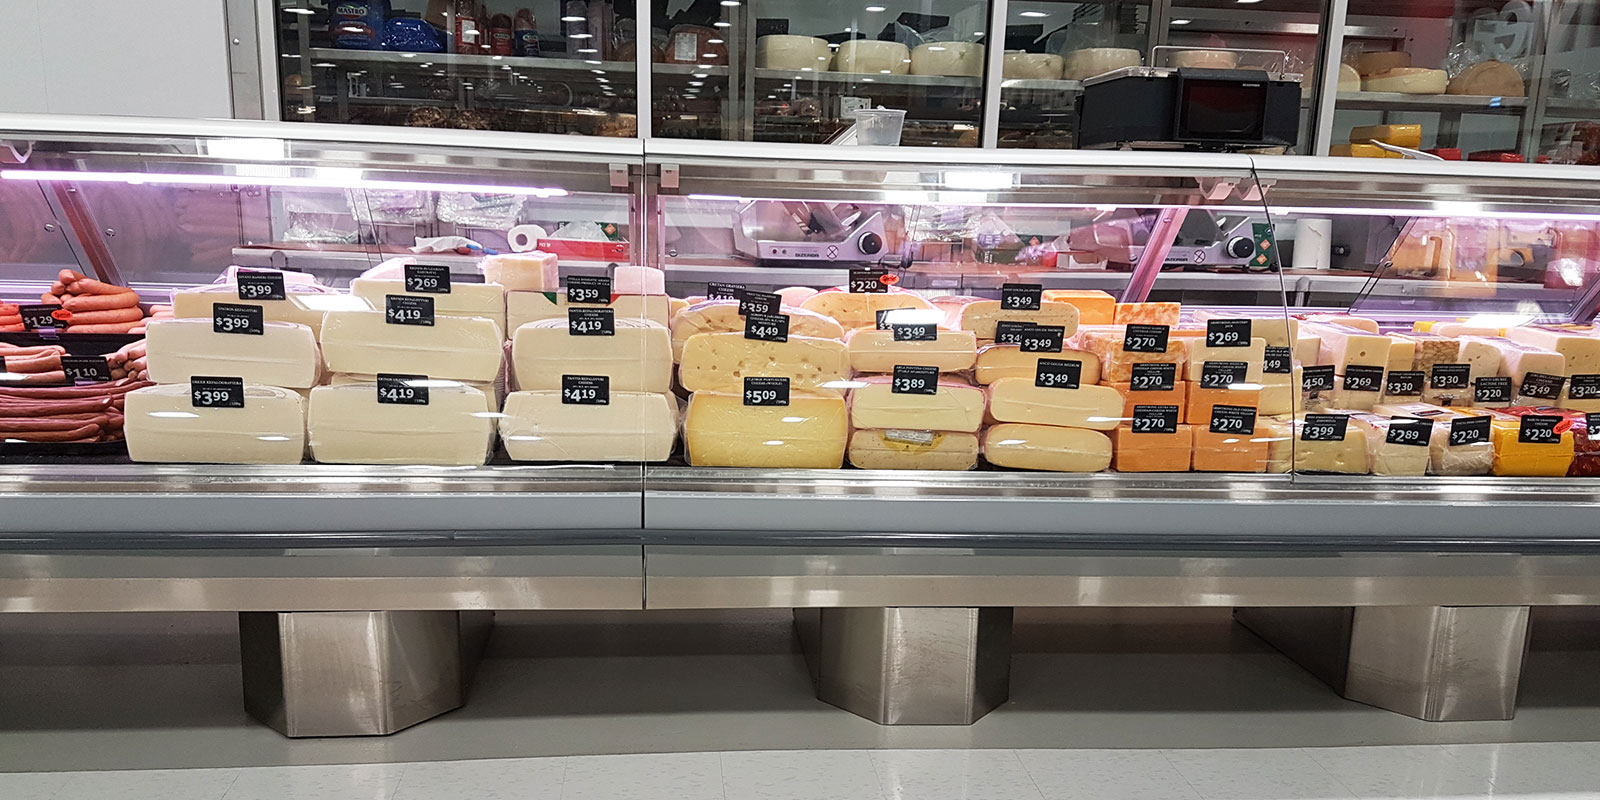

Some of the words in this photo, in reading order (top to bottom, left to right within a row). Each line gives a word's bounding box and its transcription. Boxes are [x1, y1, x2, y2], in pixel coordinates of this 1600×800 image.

[338, 7, 365, 15] MASTRO
[407, 277, 438, 291] $269
[851, 281, 878, 292] $220
[240, 285, 272, 298] $399
[569, 288, 599, 301] $359
[741, 302, 769, 313] $359
[1007, 296, 1033, 308] $349
[24, 316, 53, 328] $129
[388, 309, 421, 322] $419
[216, 317, 249, 331] $399
[571, 321, 602, 334] $419
[751, 325, 779, 338] $449
[898, 327, 926, 339] $349
[1024, 338, 1052, 351] $349
[1126, 337, 1156, 350] $270
[1208, 332, 1238, 345] $269
[895, 378, 925, 391] $389
[1040, 373, 1068, 386] $349
[1133, 376, 1163, 388] $270
[1203, 374, 1233, 387] $270
[1346, 377, 1371, 389] $269
[1433, 375, 1458, 387] $330
[1388, 382, 1413, 394] $330
[1477, 389, 1501, 400] $220
[1523, 384, 1550, 395] $349
[1572, 386, 1596, 397] $320
[194, 391, 229, 405] $399
[380, 388, 415, 402] $419
[564, 388, 596, 402] $419
[746, 390, 777, 404] $509
[1135, 418, 1165, 431] $270
[1212, 418, 1243, 431] $270
[1305, 427, 1334, 439] $399
[1390, 429, 1419, 442] $289
[1452, 430, 1479, 443] $220
[1525, 429, 1552, 441] $220
